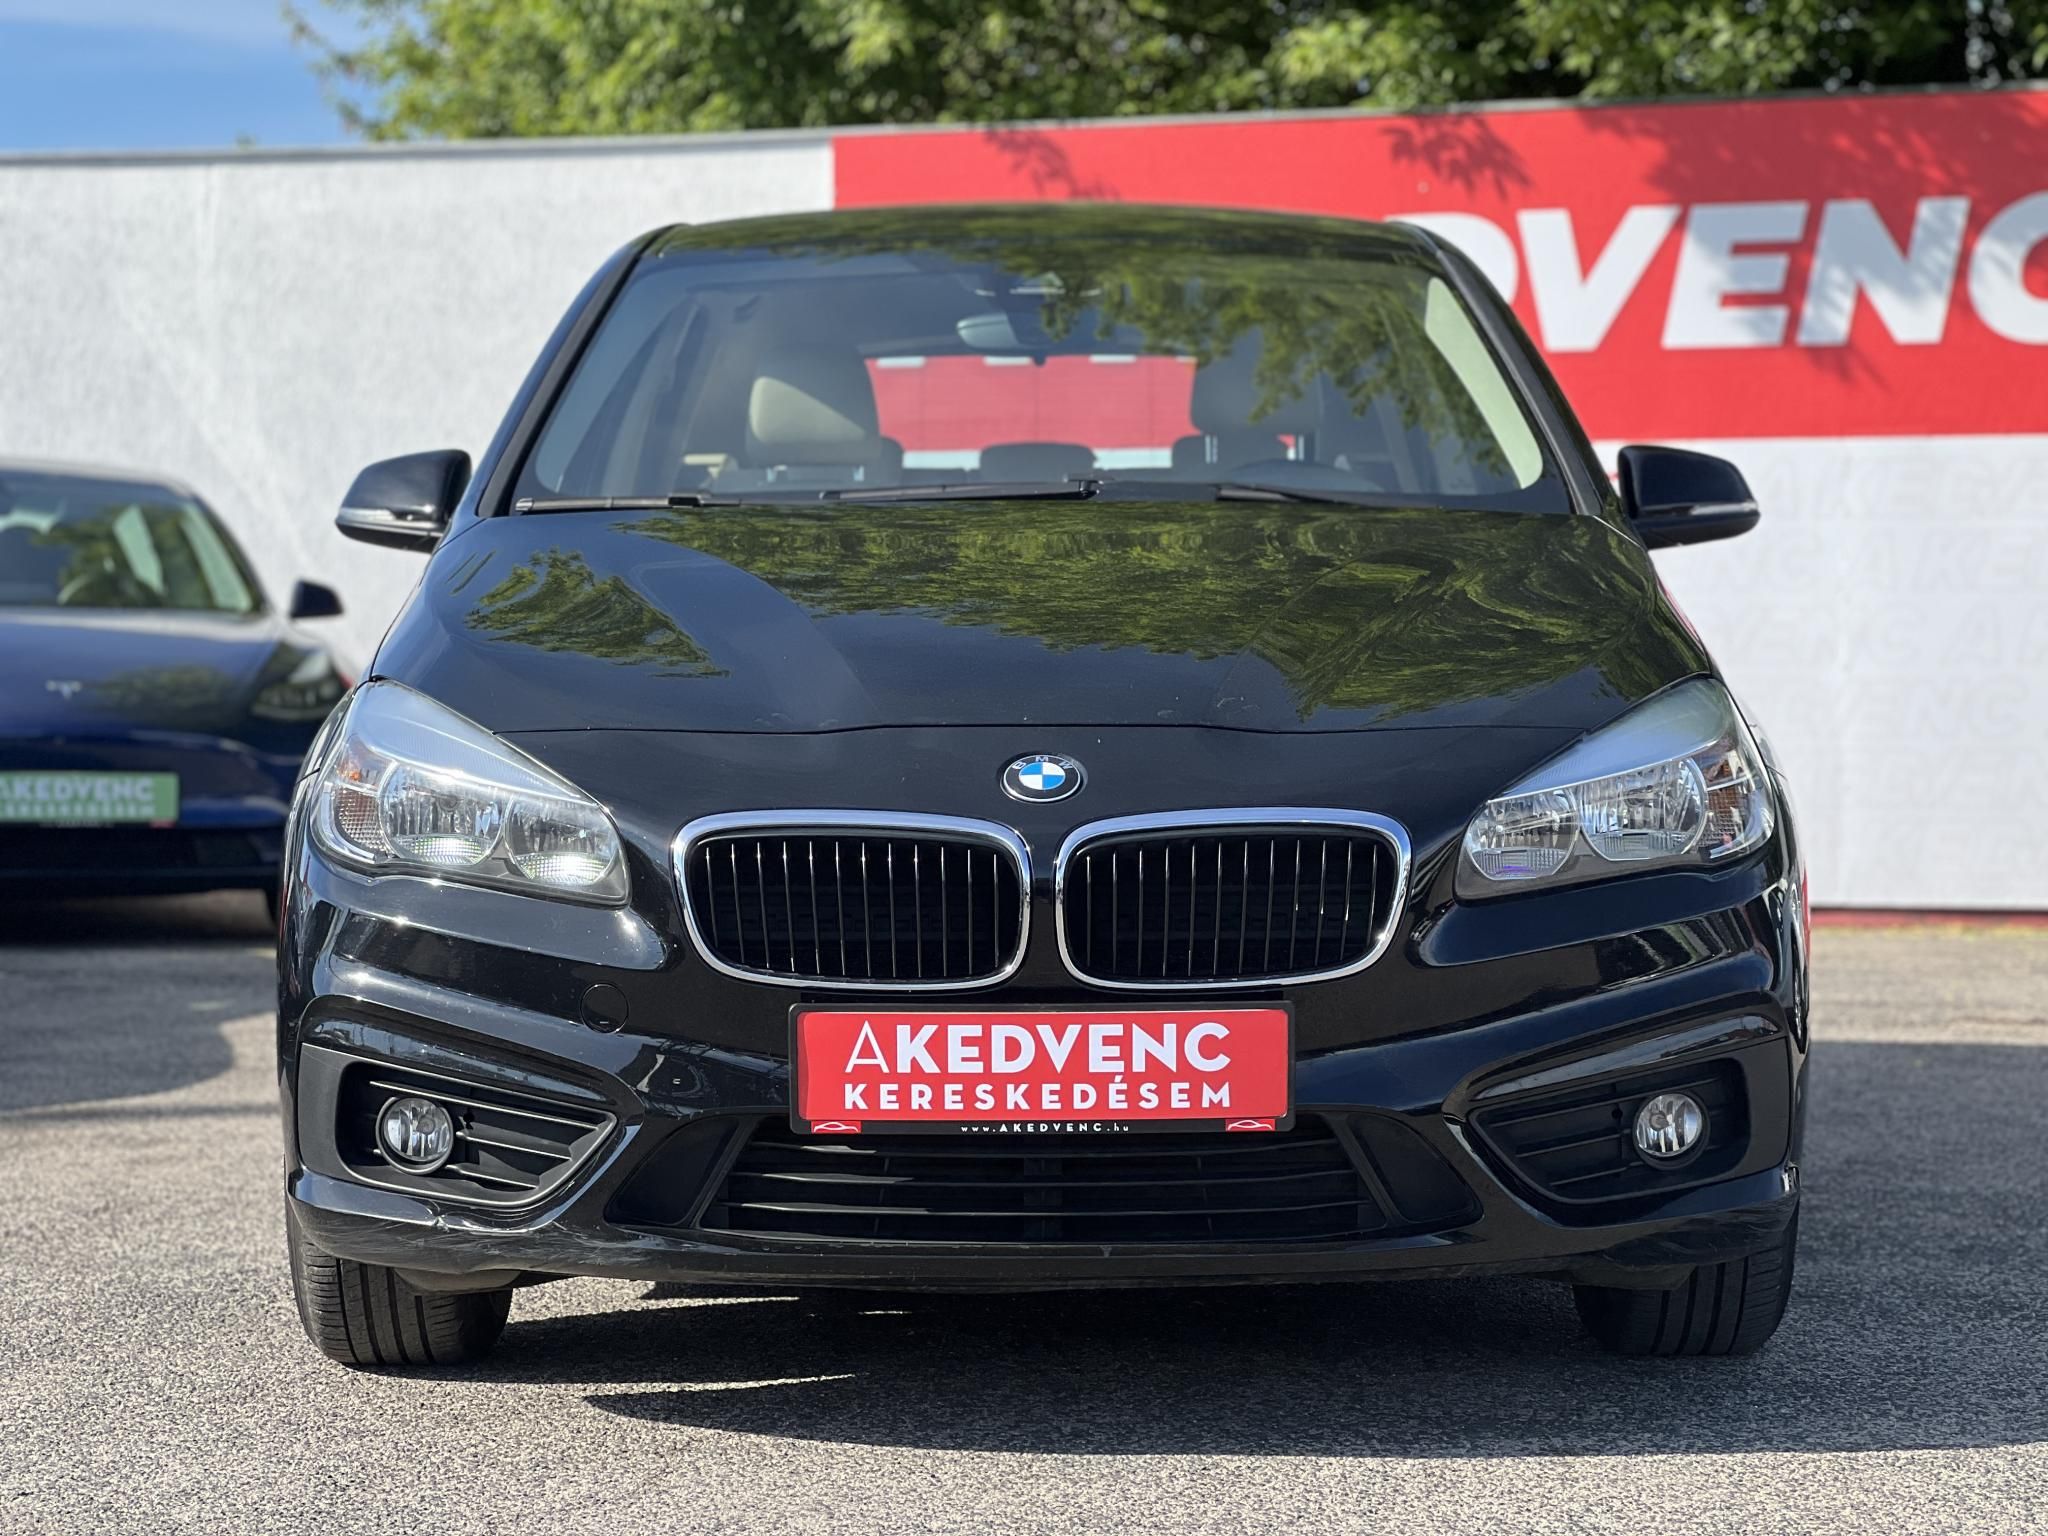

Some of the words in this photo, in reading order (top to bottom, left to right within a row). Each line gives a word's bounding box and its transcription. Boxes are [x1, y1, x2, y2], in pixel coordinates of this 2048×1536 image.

[1011, 755, 1073, 770] BMW
[843, 1075, 1231, 1110] KERESKEDÉSEM
[960, 1122, 1129, 1133] www.AKEDVENC.hu
